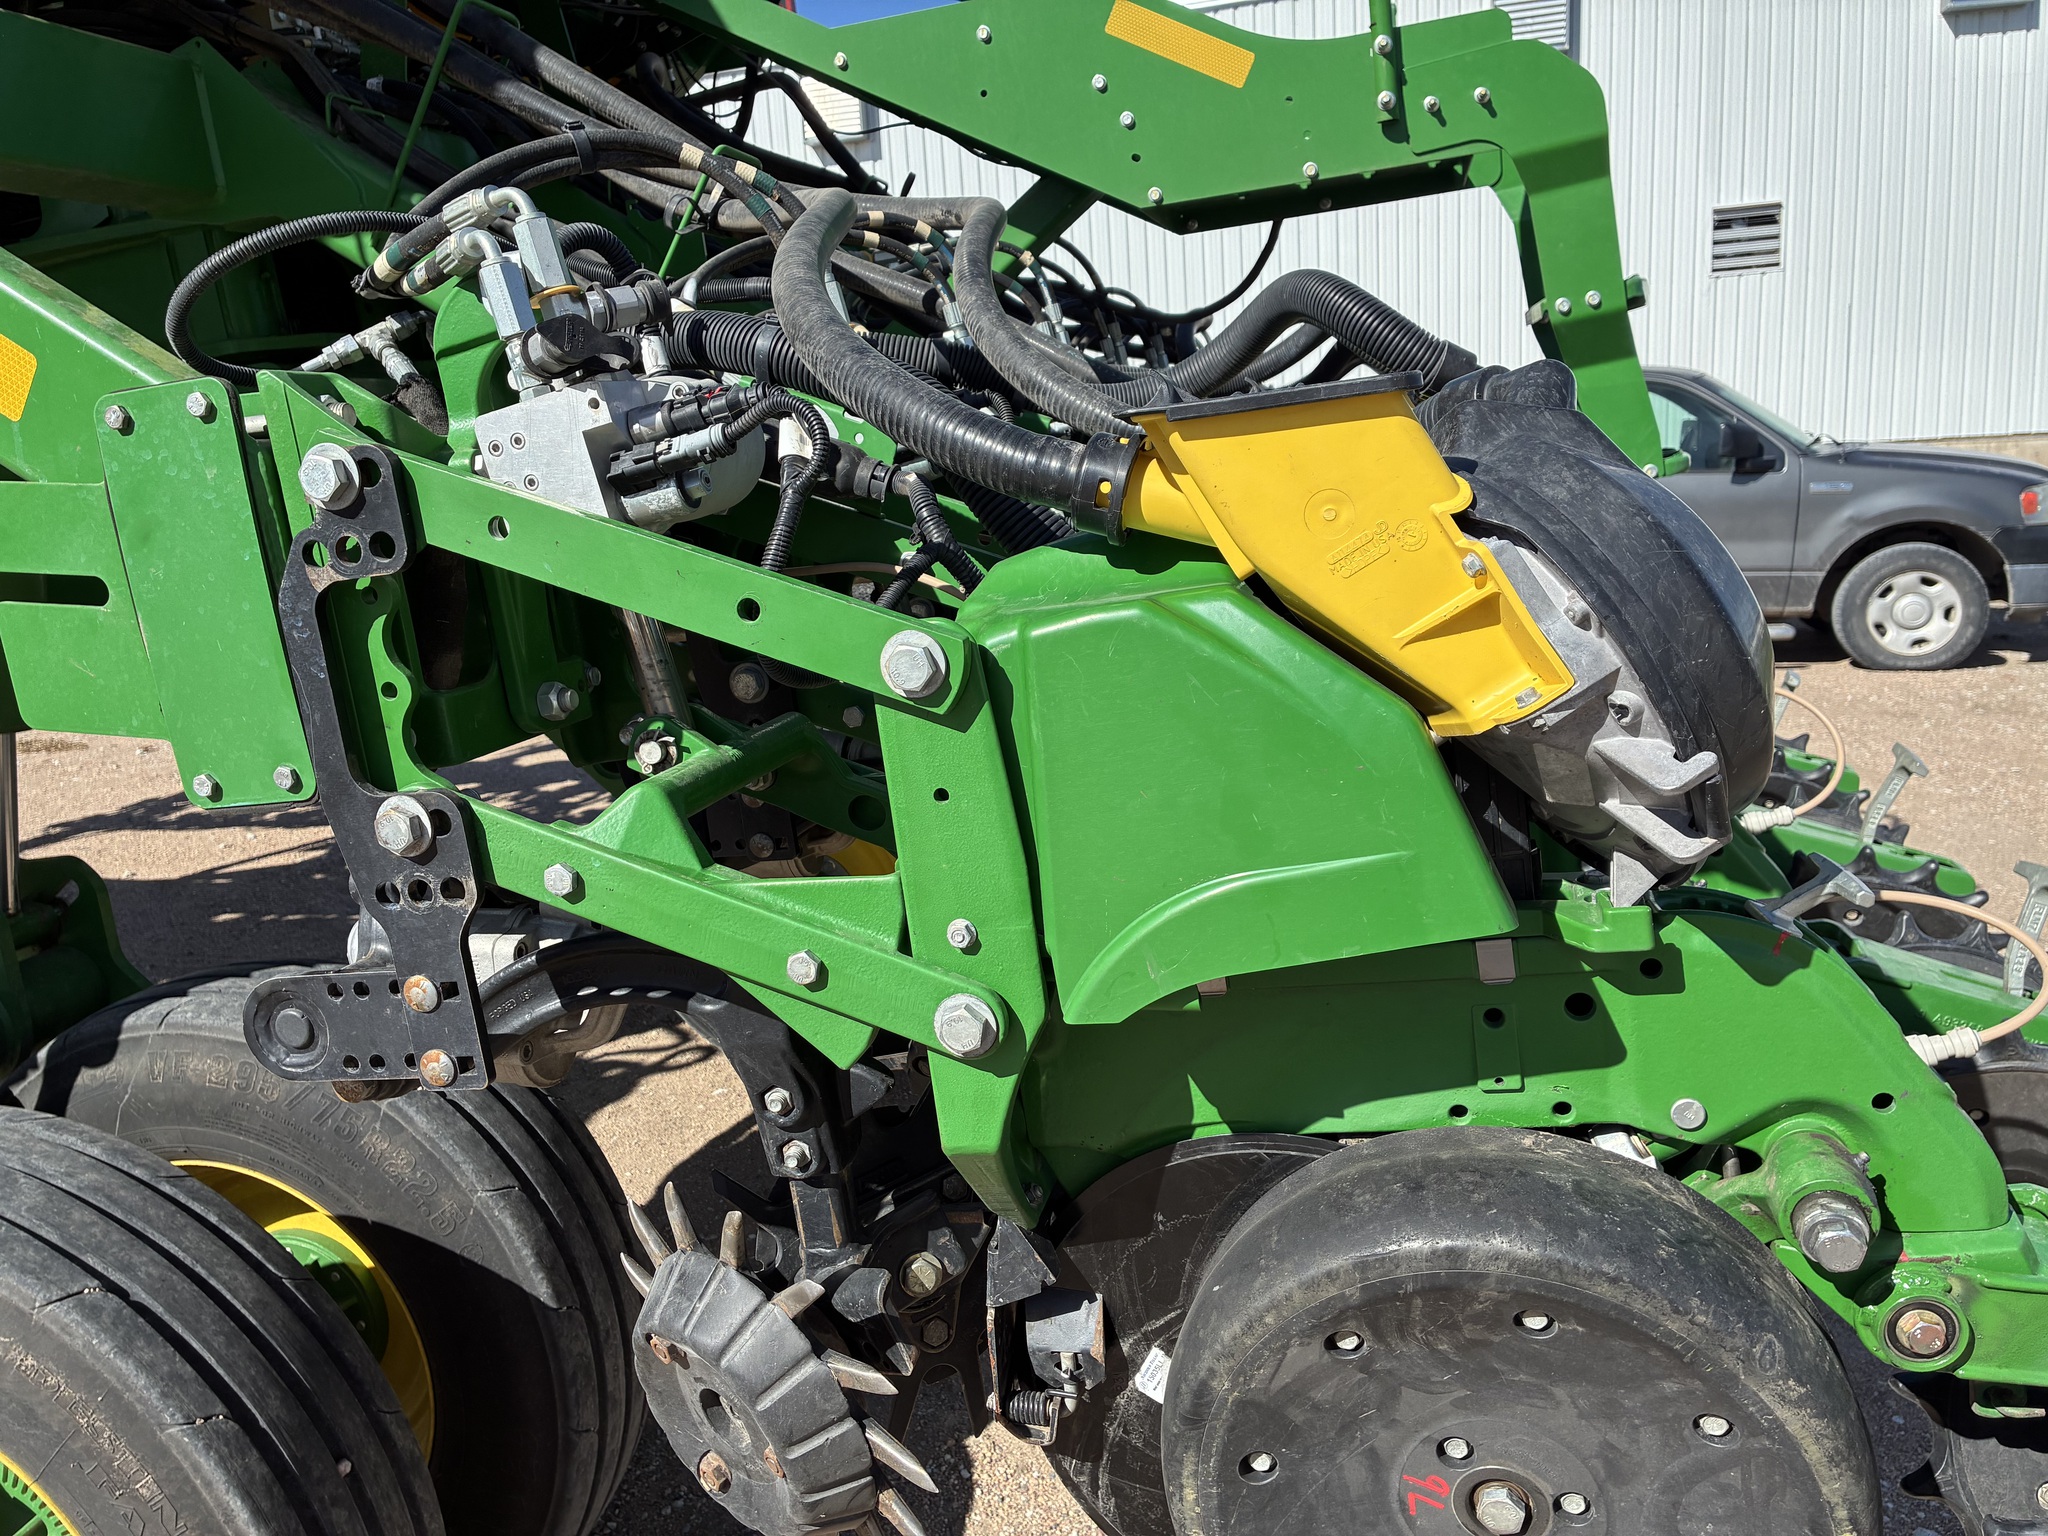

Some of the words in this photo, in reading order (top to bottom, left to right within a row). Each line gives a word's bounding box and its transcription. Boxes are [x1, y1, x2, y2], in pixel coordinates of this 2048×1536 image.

[1329, 551, 1357, 576] MADE
[1372, 532, 1397, 549] USA
[146, 1050, 195, 1085] VF
